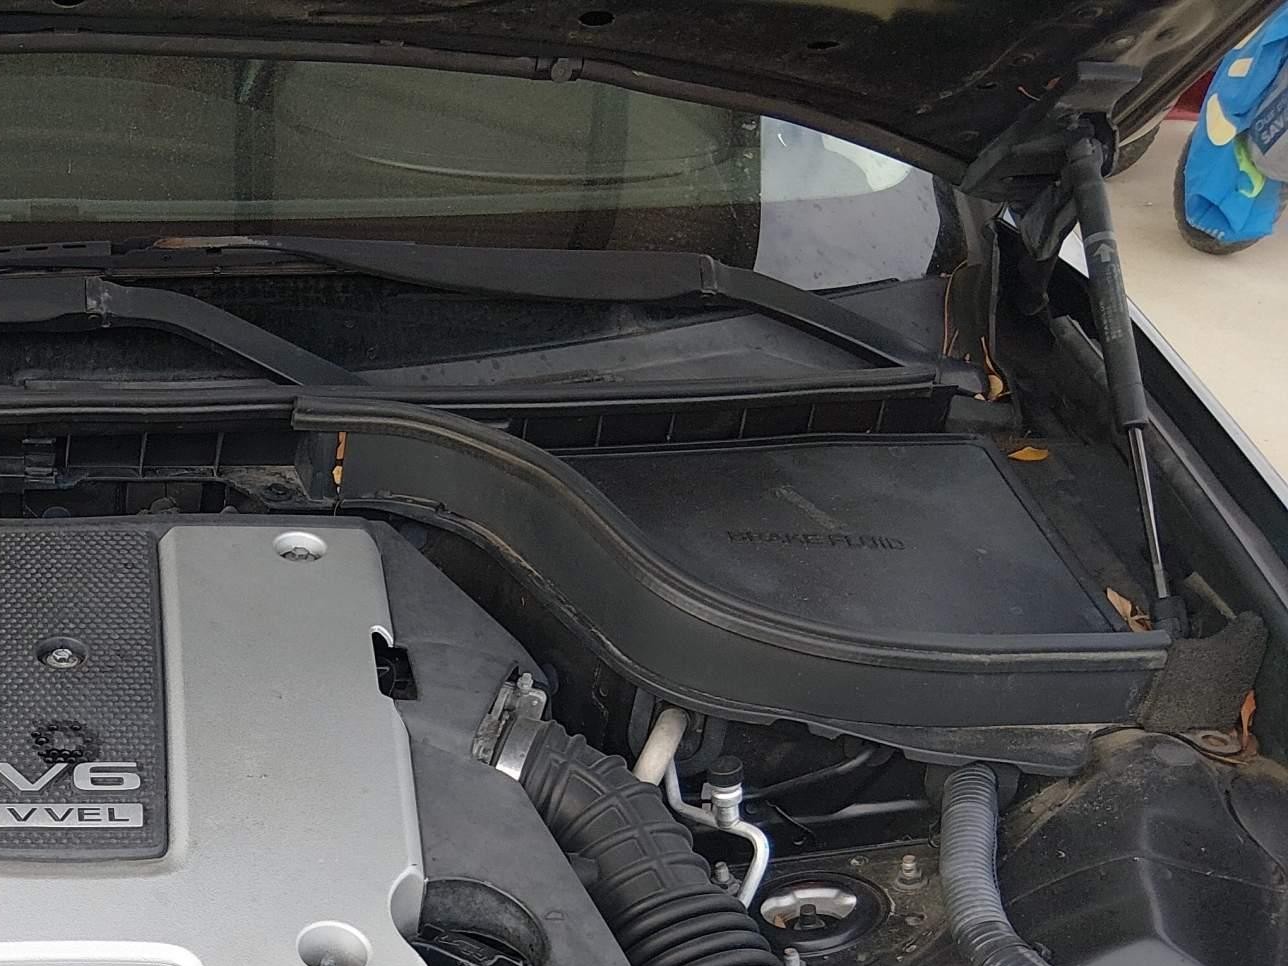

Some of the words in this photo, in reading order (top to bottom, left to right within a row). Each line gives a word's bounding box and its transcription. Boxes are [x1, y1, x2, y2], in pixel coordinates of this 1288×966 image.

[727, 530, 825, 546] BRAKE
[827, 534, 906, 550] FLUID
[6, 807, 130, 822] VVEL
